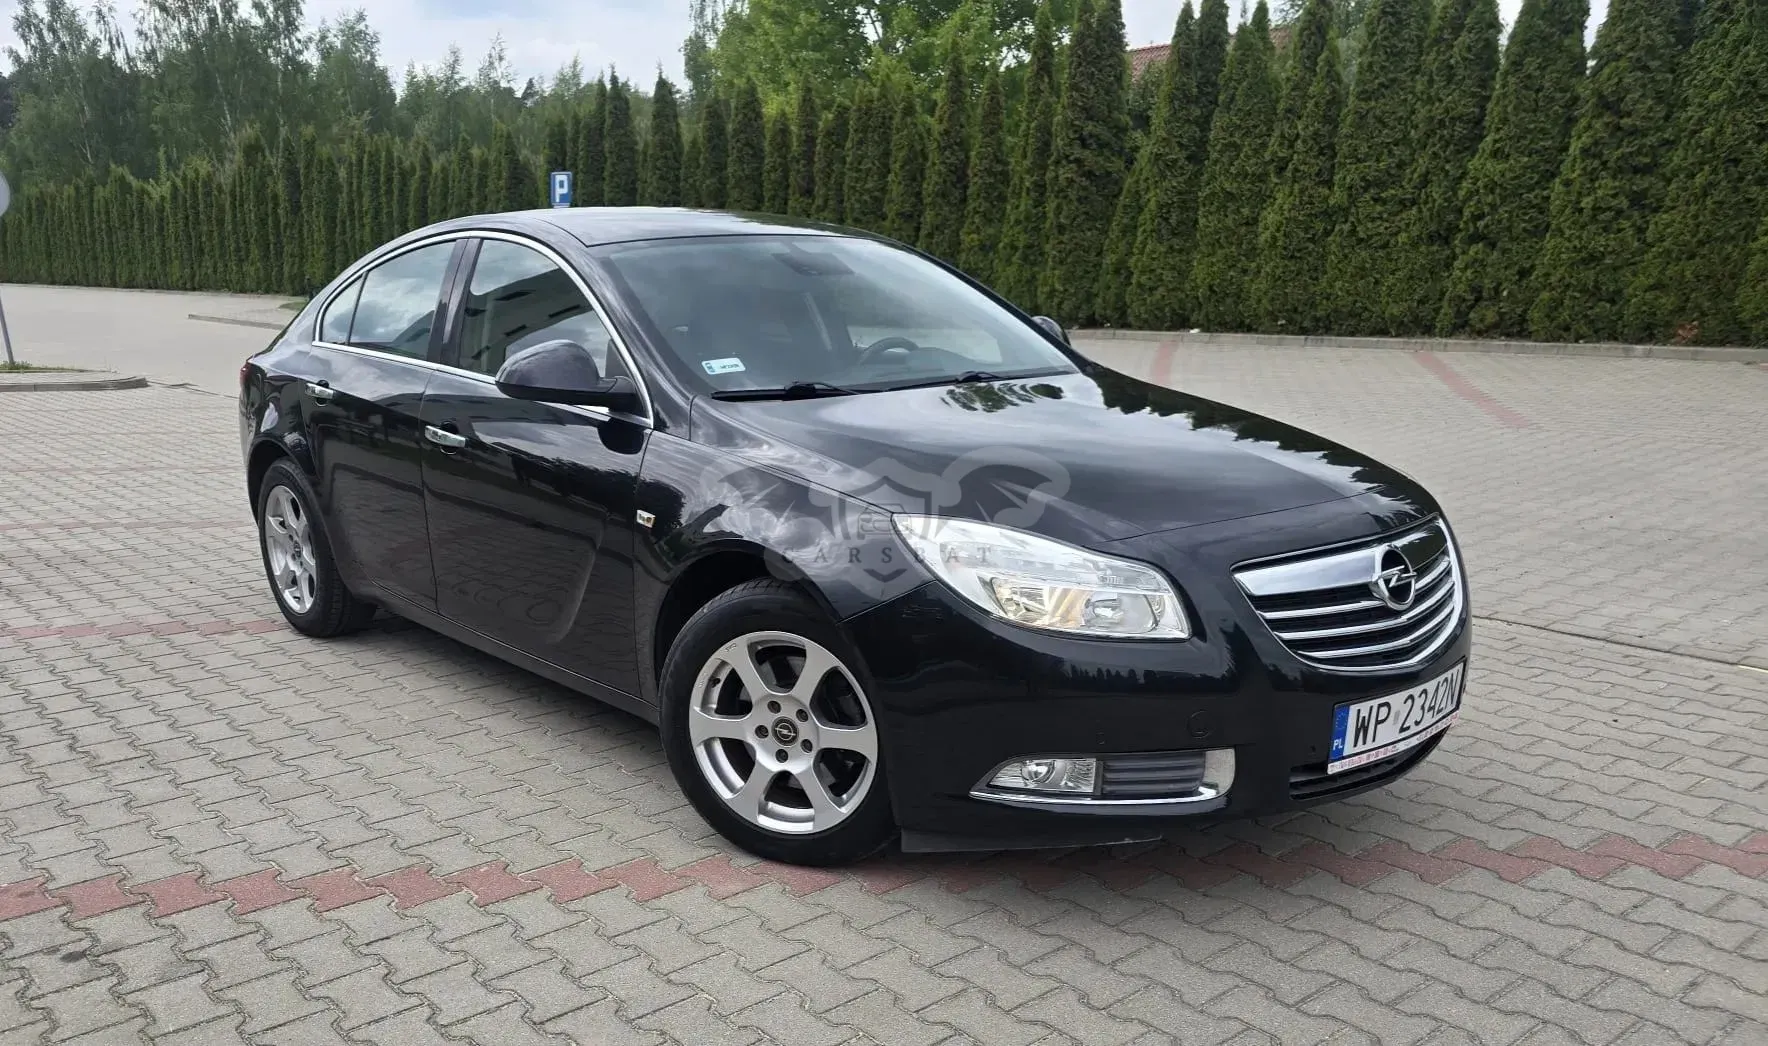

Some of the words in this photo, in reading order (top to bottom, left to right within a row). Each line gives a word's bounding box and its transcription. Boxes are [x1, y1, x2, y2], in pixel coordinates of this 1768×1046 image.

[555, 174, 568, 202] P
[1353, 701, 1391, 748] WP
[1399, 669, 1459, 734] 2342N
[1332, 739, 1343, 751] PL
